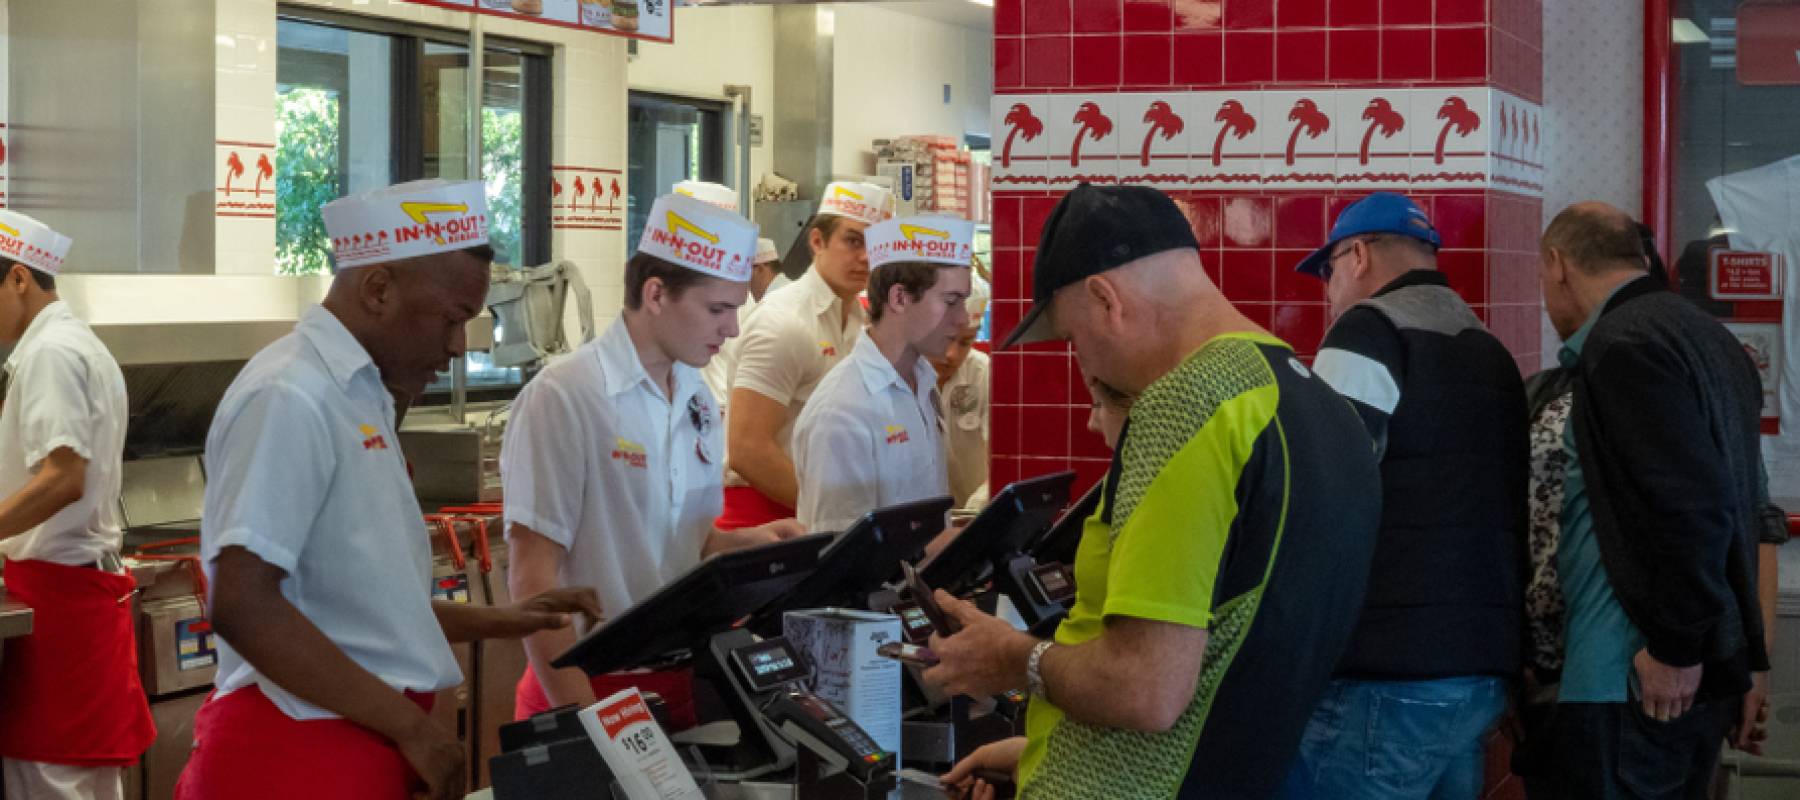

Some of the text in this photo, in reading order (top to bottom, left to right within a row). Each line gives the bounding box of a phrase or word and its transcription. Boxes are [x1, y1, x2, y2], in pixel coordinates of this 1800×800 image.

[394, 214, 478, 244] IN-N-OUT
[652, 228, 726, 262] IN-N-OUT
[893, 239, 956, 252] IN-N-OUT
